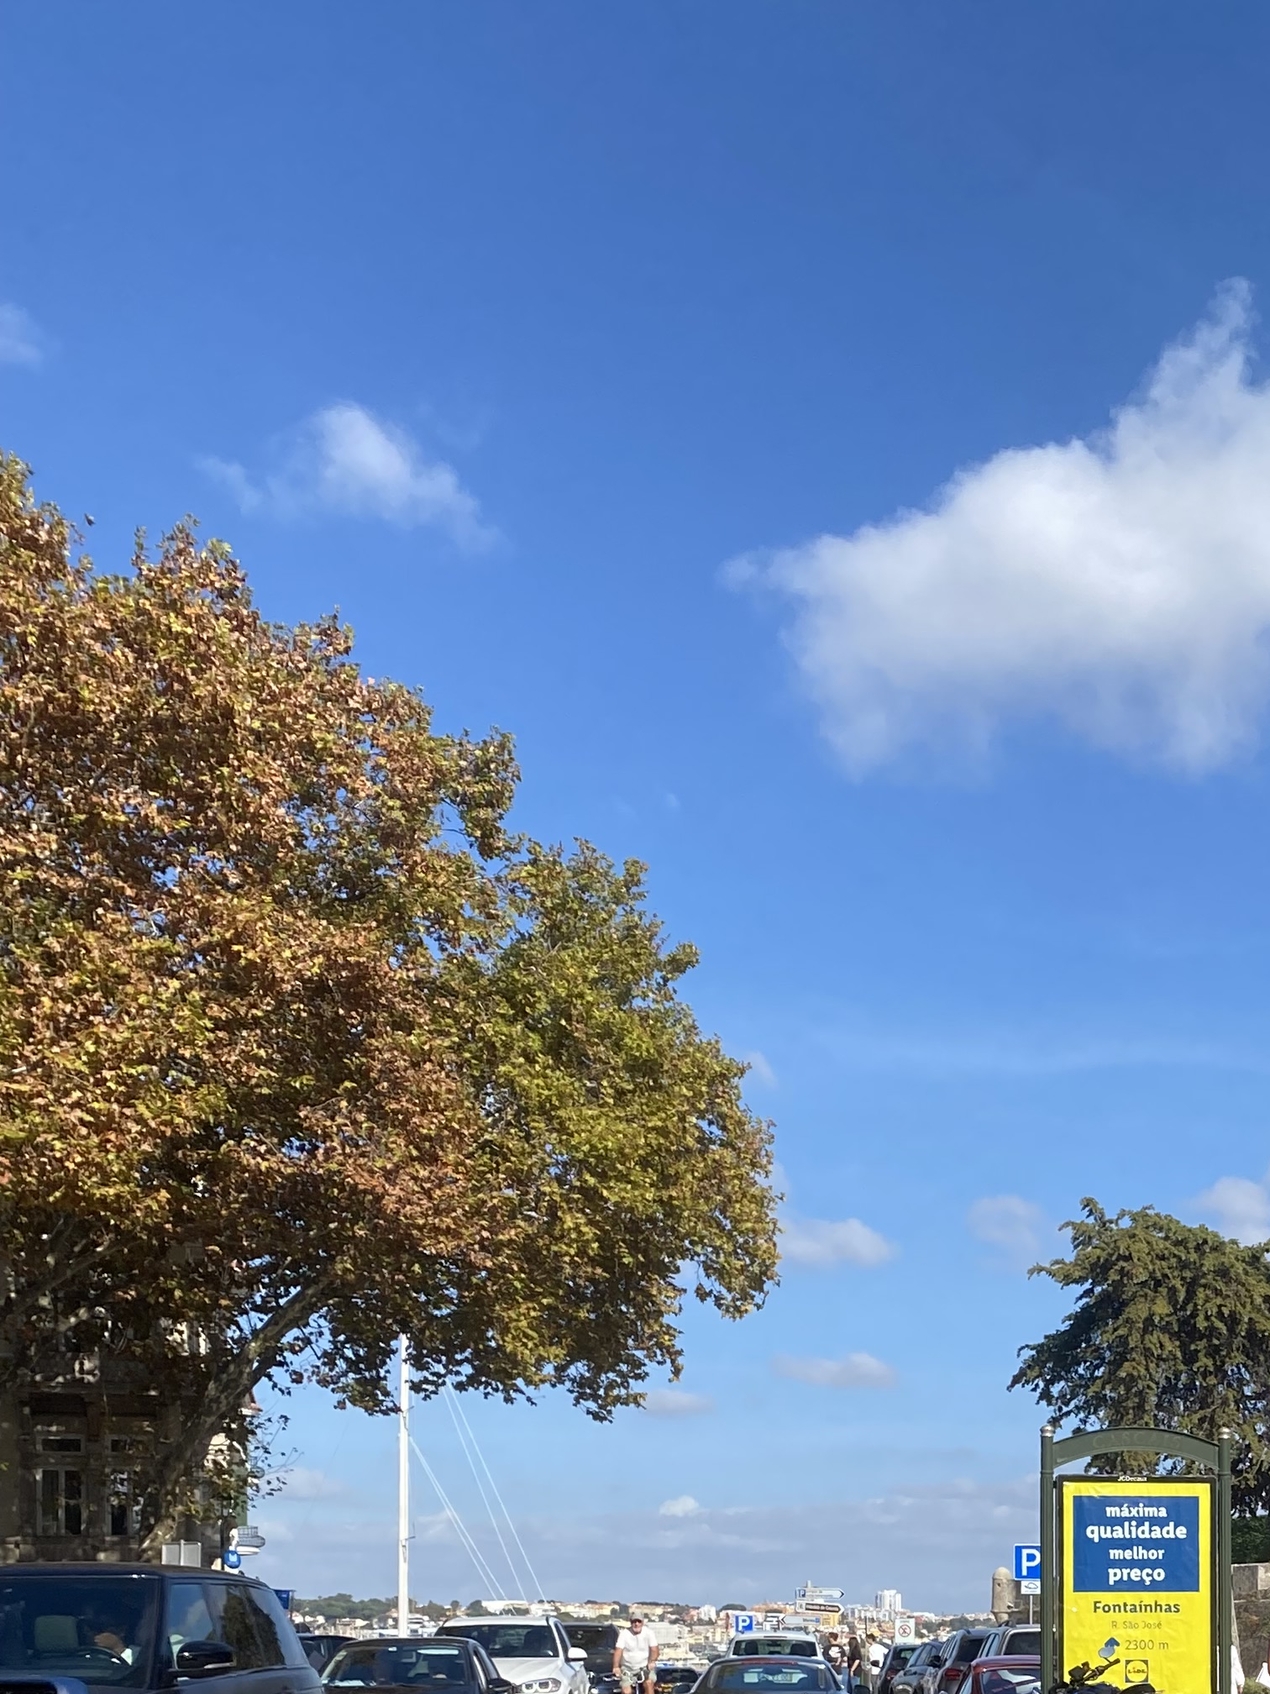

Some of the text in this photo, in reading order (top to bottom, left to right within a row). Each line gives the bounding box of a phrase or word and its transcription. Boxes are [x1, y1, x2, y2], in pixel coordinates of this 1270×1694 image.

[1105, 1503, 1168, 1518] máxima
[1085, 1520, 1187, 1543] qualidade
[1109, 1546, 1165, 1560] melhor
[1022, 1549, 1041, 1576] P
[1108, 1567, 1165, 1586] preço
[1093, 1600, 1181, 1614] Fontaínhas
[738, 1616, 750, 1631] P
[1125, 1639, 1169, 1650] 2300 m
